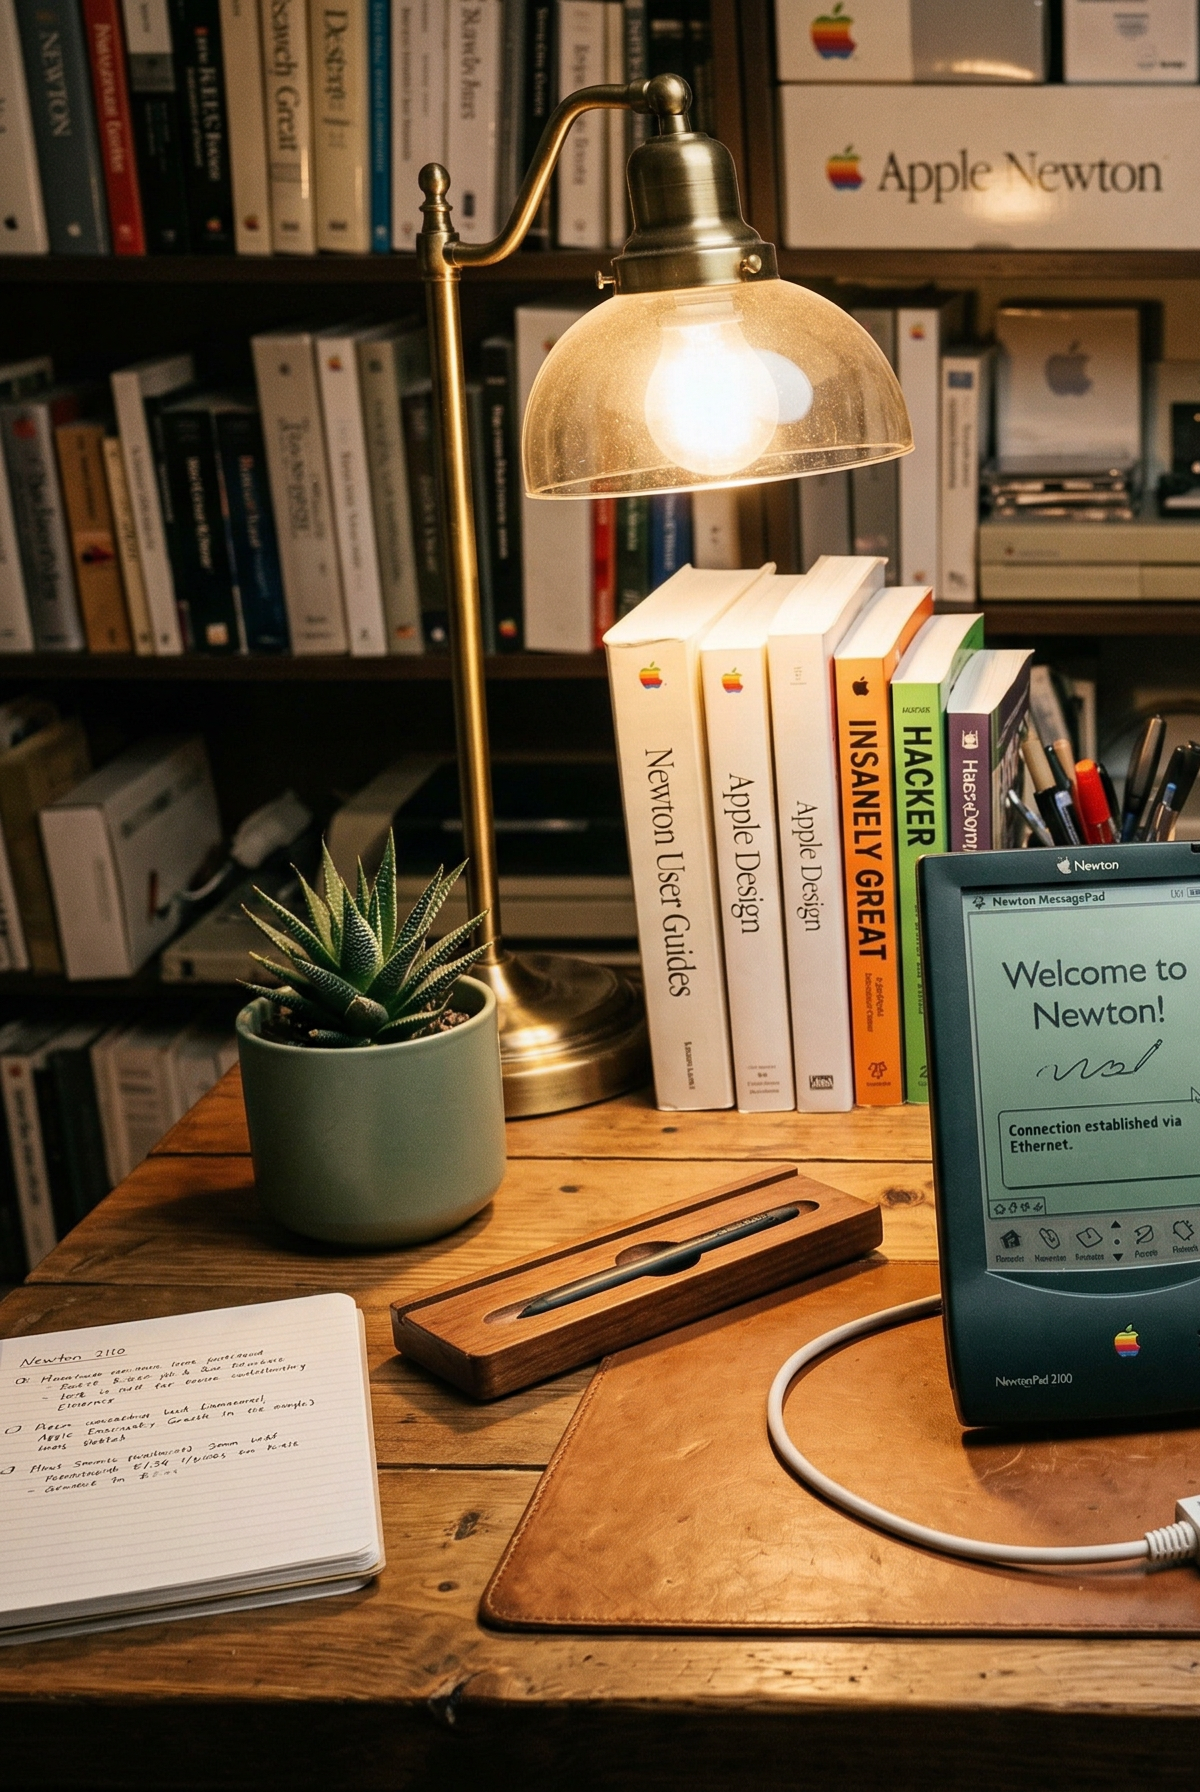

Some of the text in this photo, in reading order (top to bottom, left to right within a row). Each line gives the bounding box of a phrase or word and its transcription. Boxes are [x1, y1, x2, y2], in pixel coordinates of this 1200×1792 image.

[39, 31, 71, 138] NEWTON
[878, 149, 1163, 203] Apple Newton
[849, 720, 882, 860] INSANELY
[902, 726, 936, 847] HACKER
[645, 748, 696, 998] Newton User Guides
[723, 774, 764, 934] Apple Design
[792, 801, 825, 931] Apple Design
[1074, 859, 1119, 872] Newton
[855, 869, 887, 960] GREAT
[992, 895, 1036, 907] Newton
[1002, 958, 1187, 990] Welcome to
[1033, 996, 1165, 1030] Newton!
[1009, 1115, 1182, 1138] Connection established via
[1010, 1138, 1074, 1154] Ethernet.
[20, 1354, 82, 1367] Newton
[1051, 1373, 1073, 1385] 2100
